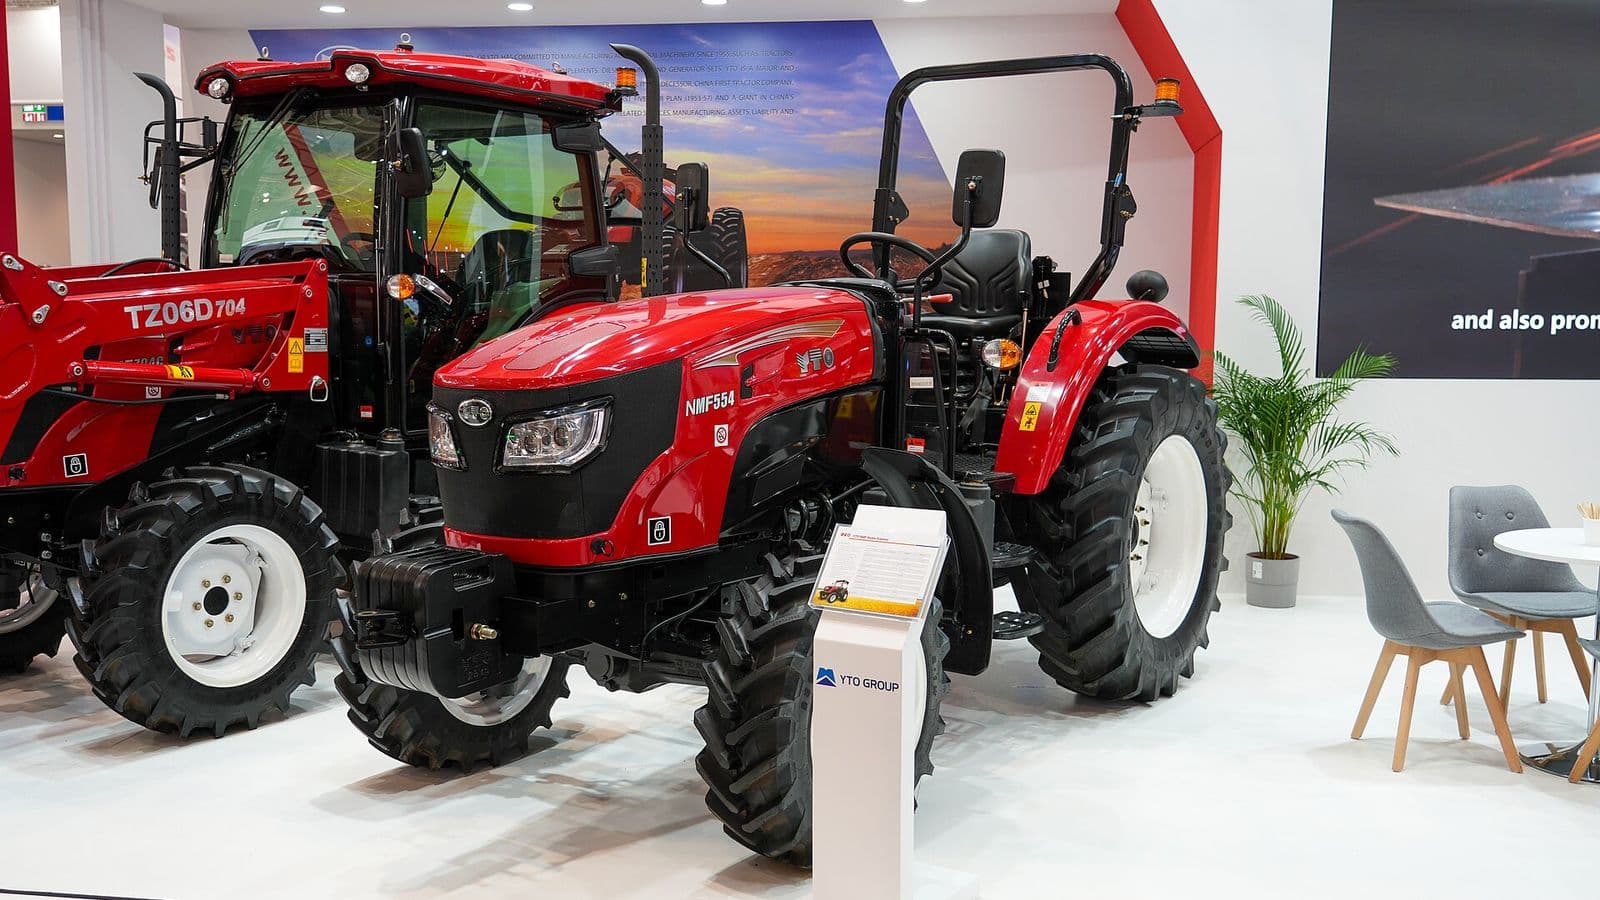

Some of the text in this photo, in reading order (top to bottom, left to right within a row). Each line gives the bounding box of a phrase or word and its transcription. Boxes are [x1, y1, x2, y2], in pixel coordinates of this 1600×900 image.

[124, 297, 246, 329] TZ06D 704
[1451, 308, 1493, 330] and
[1499, 308, 1544, 330] also
[685, 390, 735, 417] NMF554
[840, 674, 899, 692] YTO GROUP
